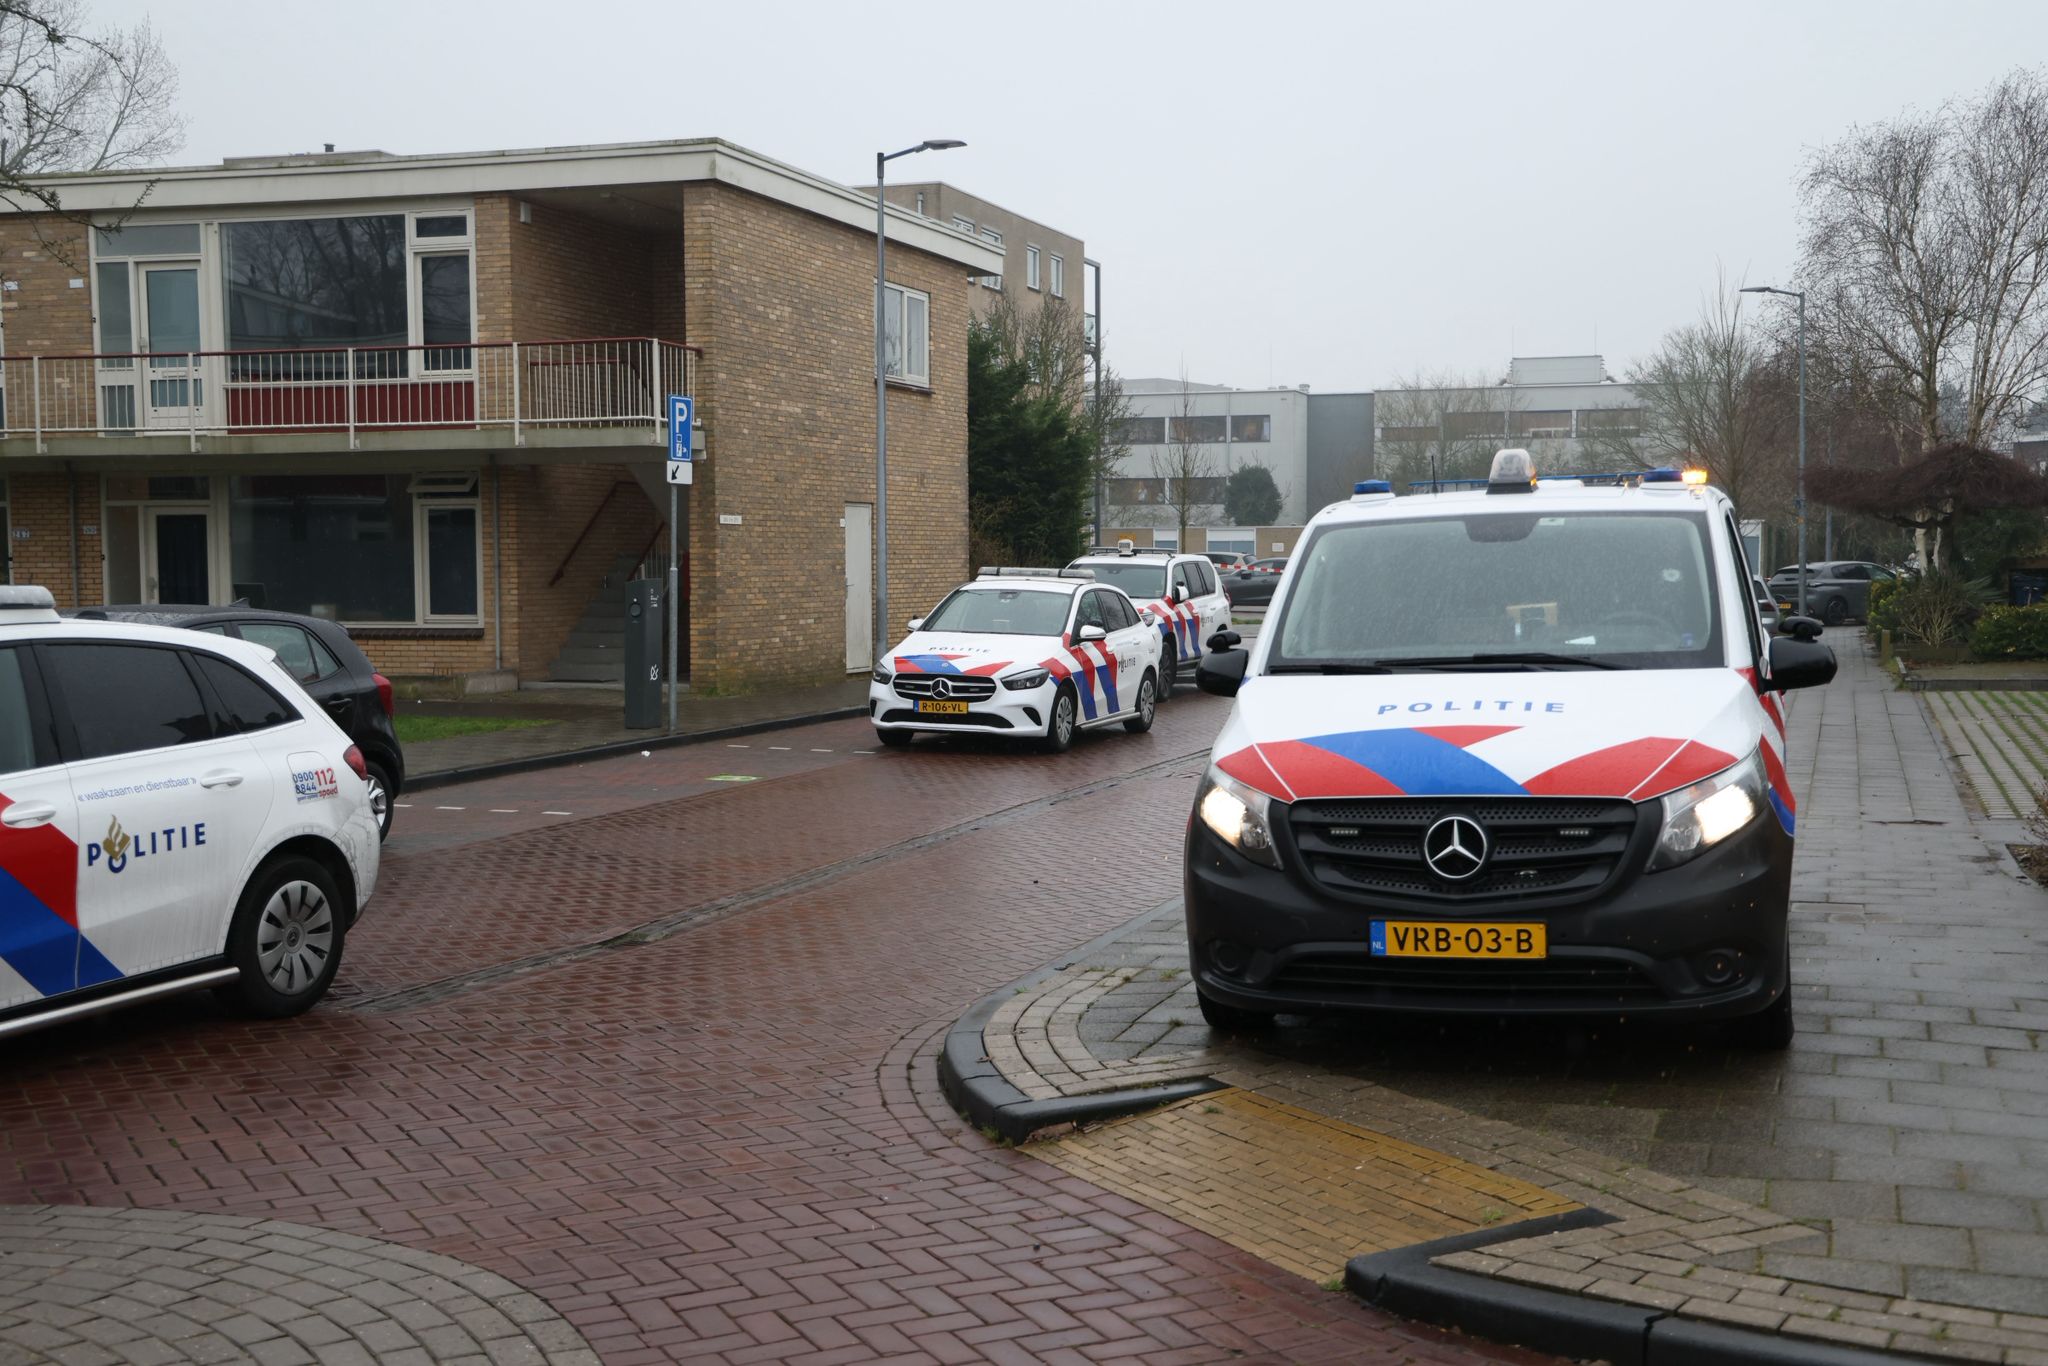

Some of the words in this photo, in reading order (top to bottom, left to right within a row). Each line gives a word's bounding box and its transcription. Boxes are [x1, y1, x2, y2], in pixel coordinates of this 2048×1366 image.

[675, 402, 688, 433] P
[922, 702, 963, 712] R-106-VL
[1377, 700, 1565, 715] POLITIE
[292, 771, 314, 783] 0900
[315, 767, 337, 786] 112
[85, 786, 134, 801] waakzaam
[134, 784, 147, 793] en
[146, 778, 190, 792] dienstbaar
[295, 782, 317, 794] 8844
[87, 823, 206, 874] POLITIE
[1372, 941, 1384, 950] NL
[1392, 926, 1534, 954] VRB-03-B
